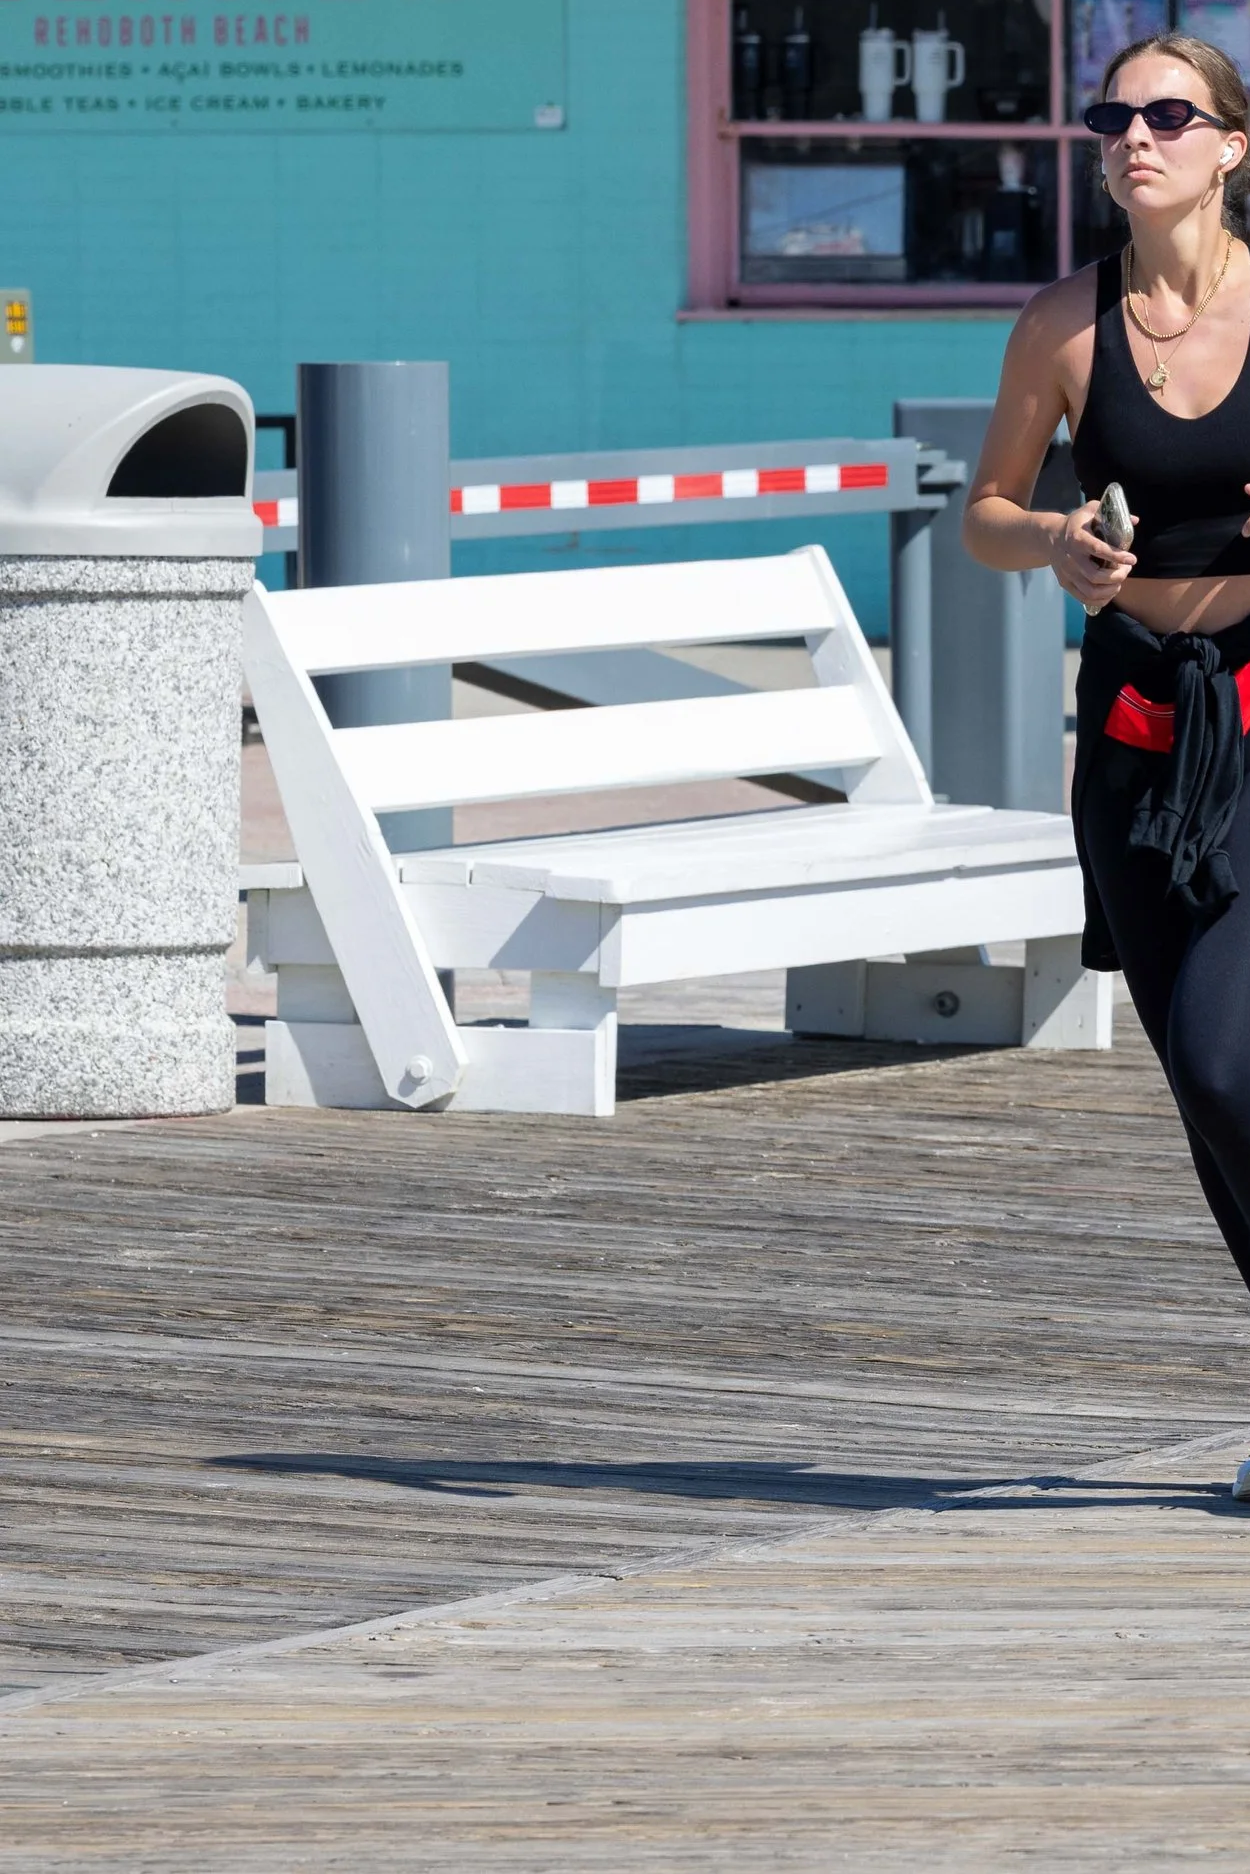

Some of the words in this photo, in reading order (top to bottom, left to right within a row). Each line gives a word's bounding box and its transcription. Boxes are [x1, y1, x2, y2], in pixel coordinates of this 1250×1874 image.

[34, 15, 197, 47] REHOBOTH
[212, 14, 311, 46] BEACH
[219, 61, 299, 79] BOWLS
[321, 60, 465, 79] LEMONADES
[62, 96, 119, 113] TEAS
[144, 96, 182, 112] ICE
[189, 96, 271, 112] CREAM
[295, 95, 388, 112] BAKERY
